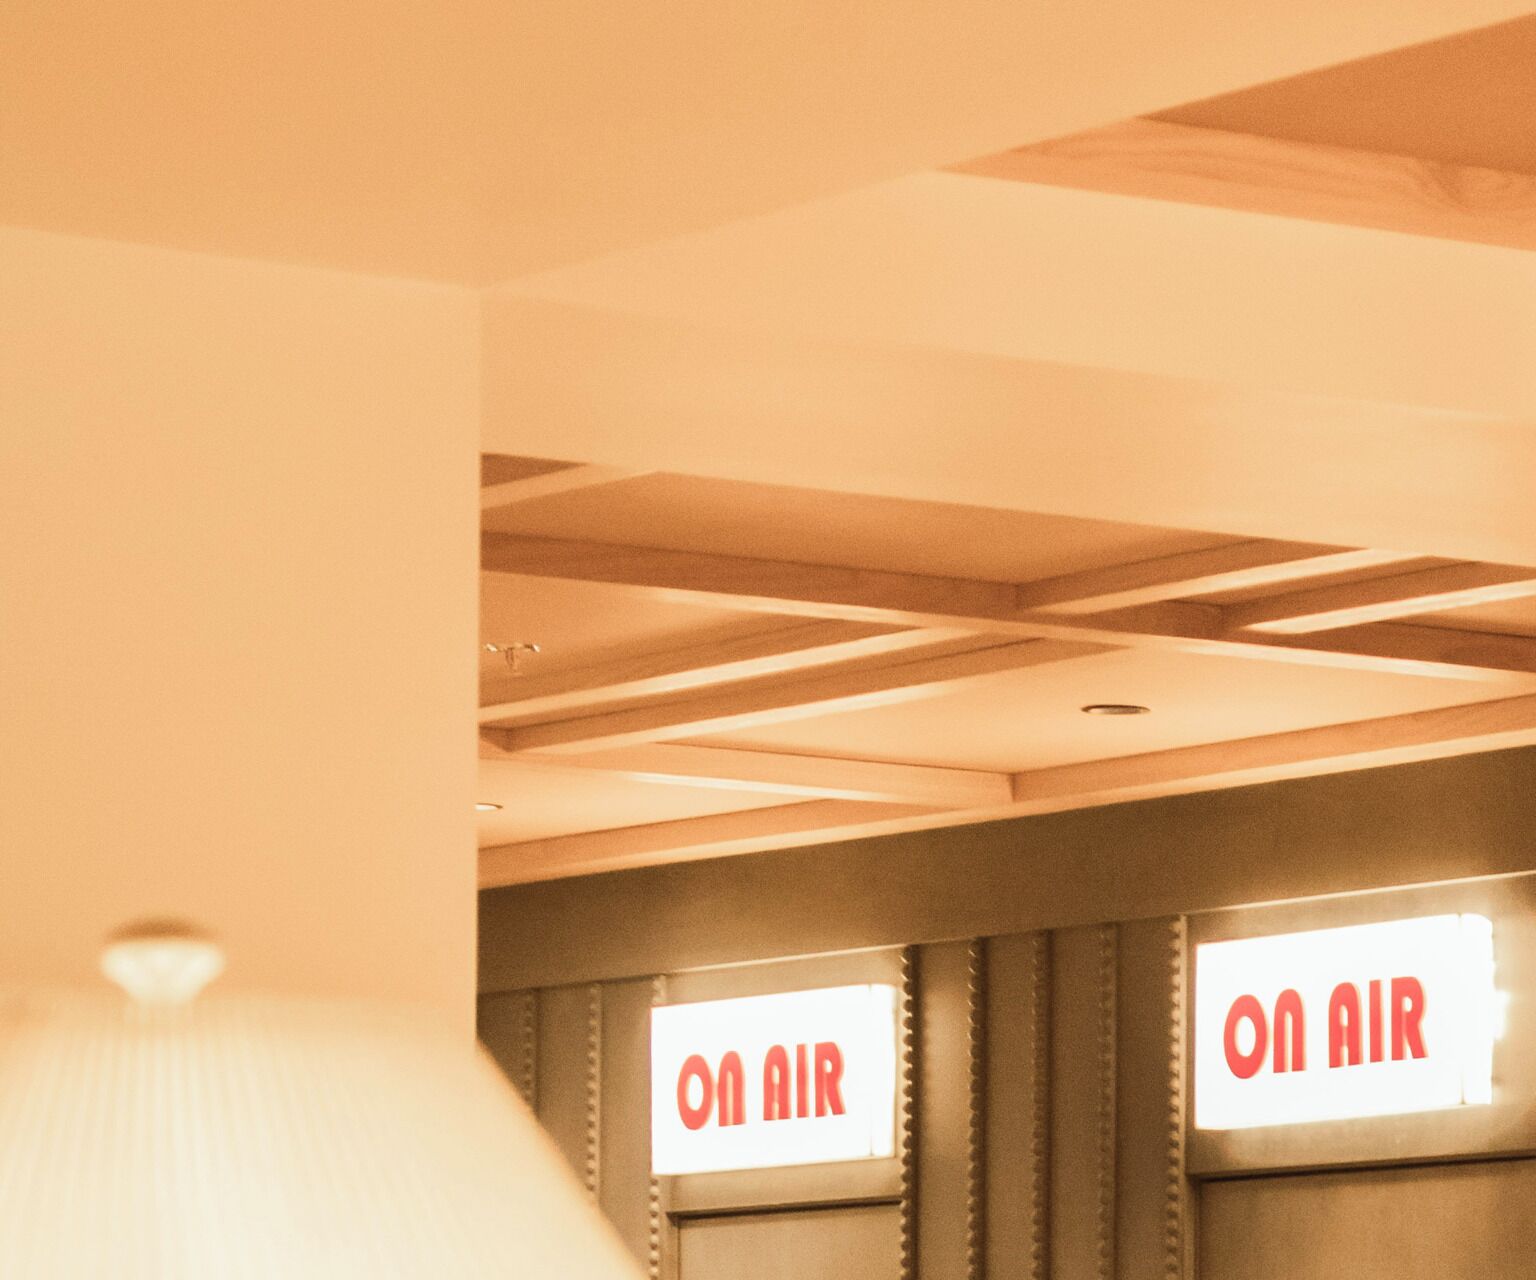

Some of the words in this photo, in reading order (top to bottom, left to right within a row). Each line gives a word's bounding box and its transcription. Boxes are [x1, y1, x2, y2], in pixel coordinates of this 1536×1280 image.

[1223, 988, 1306, 1080] ON
[1328, 976, 1428, 1069] AIR
[677, 1051, 746, 1131] ON
[763, 1041, 846, 1121] AIR
